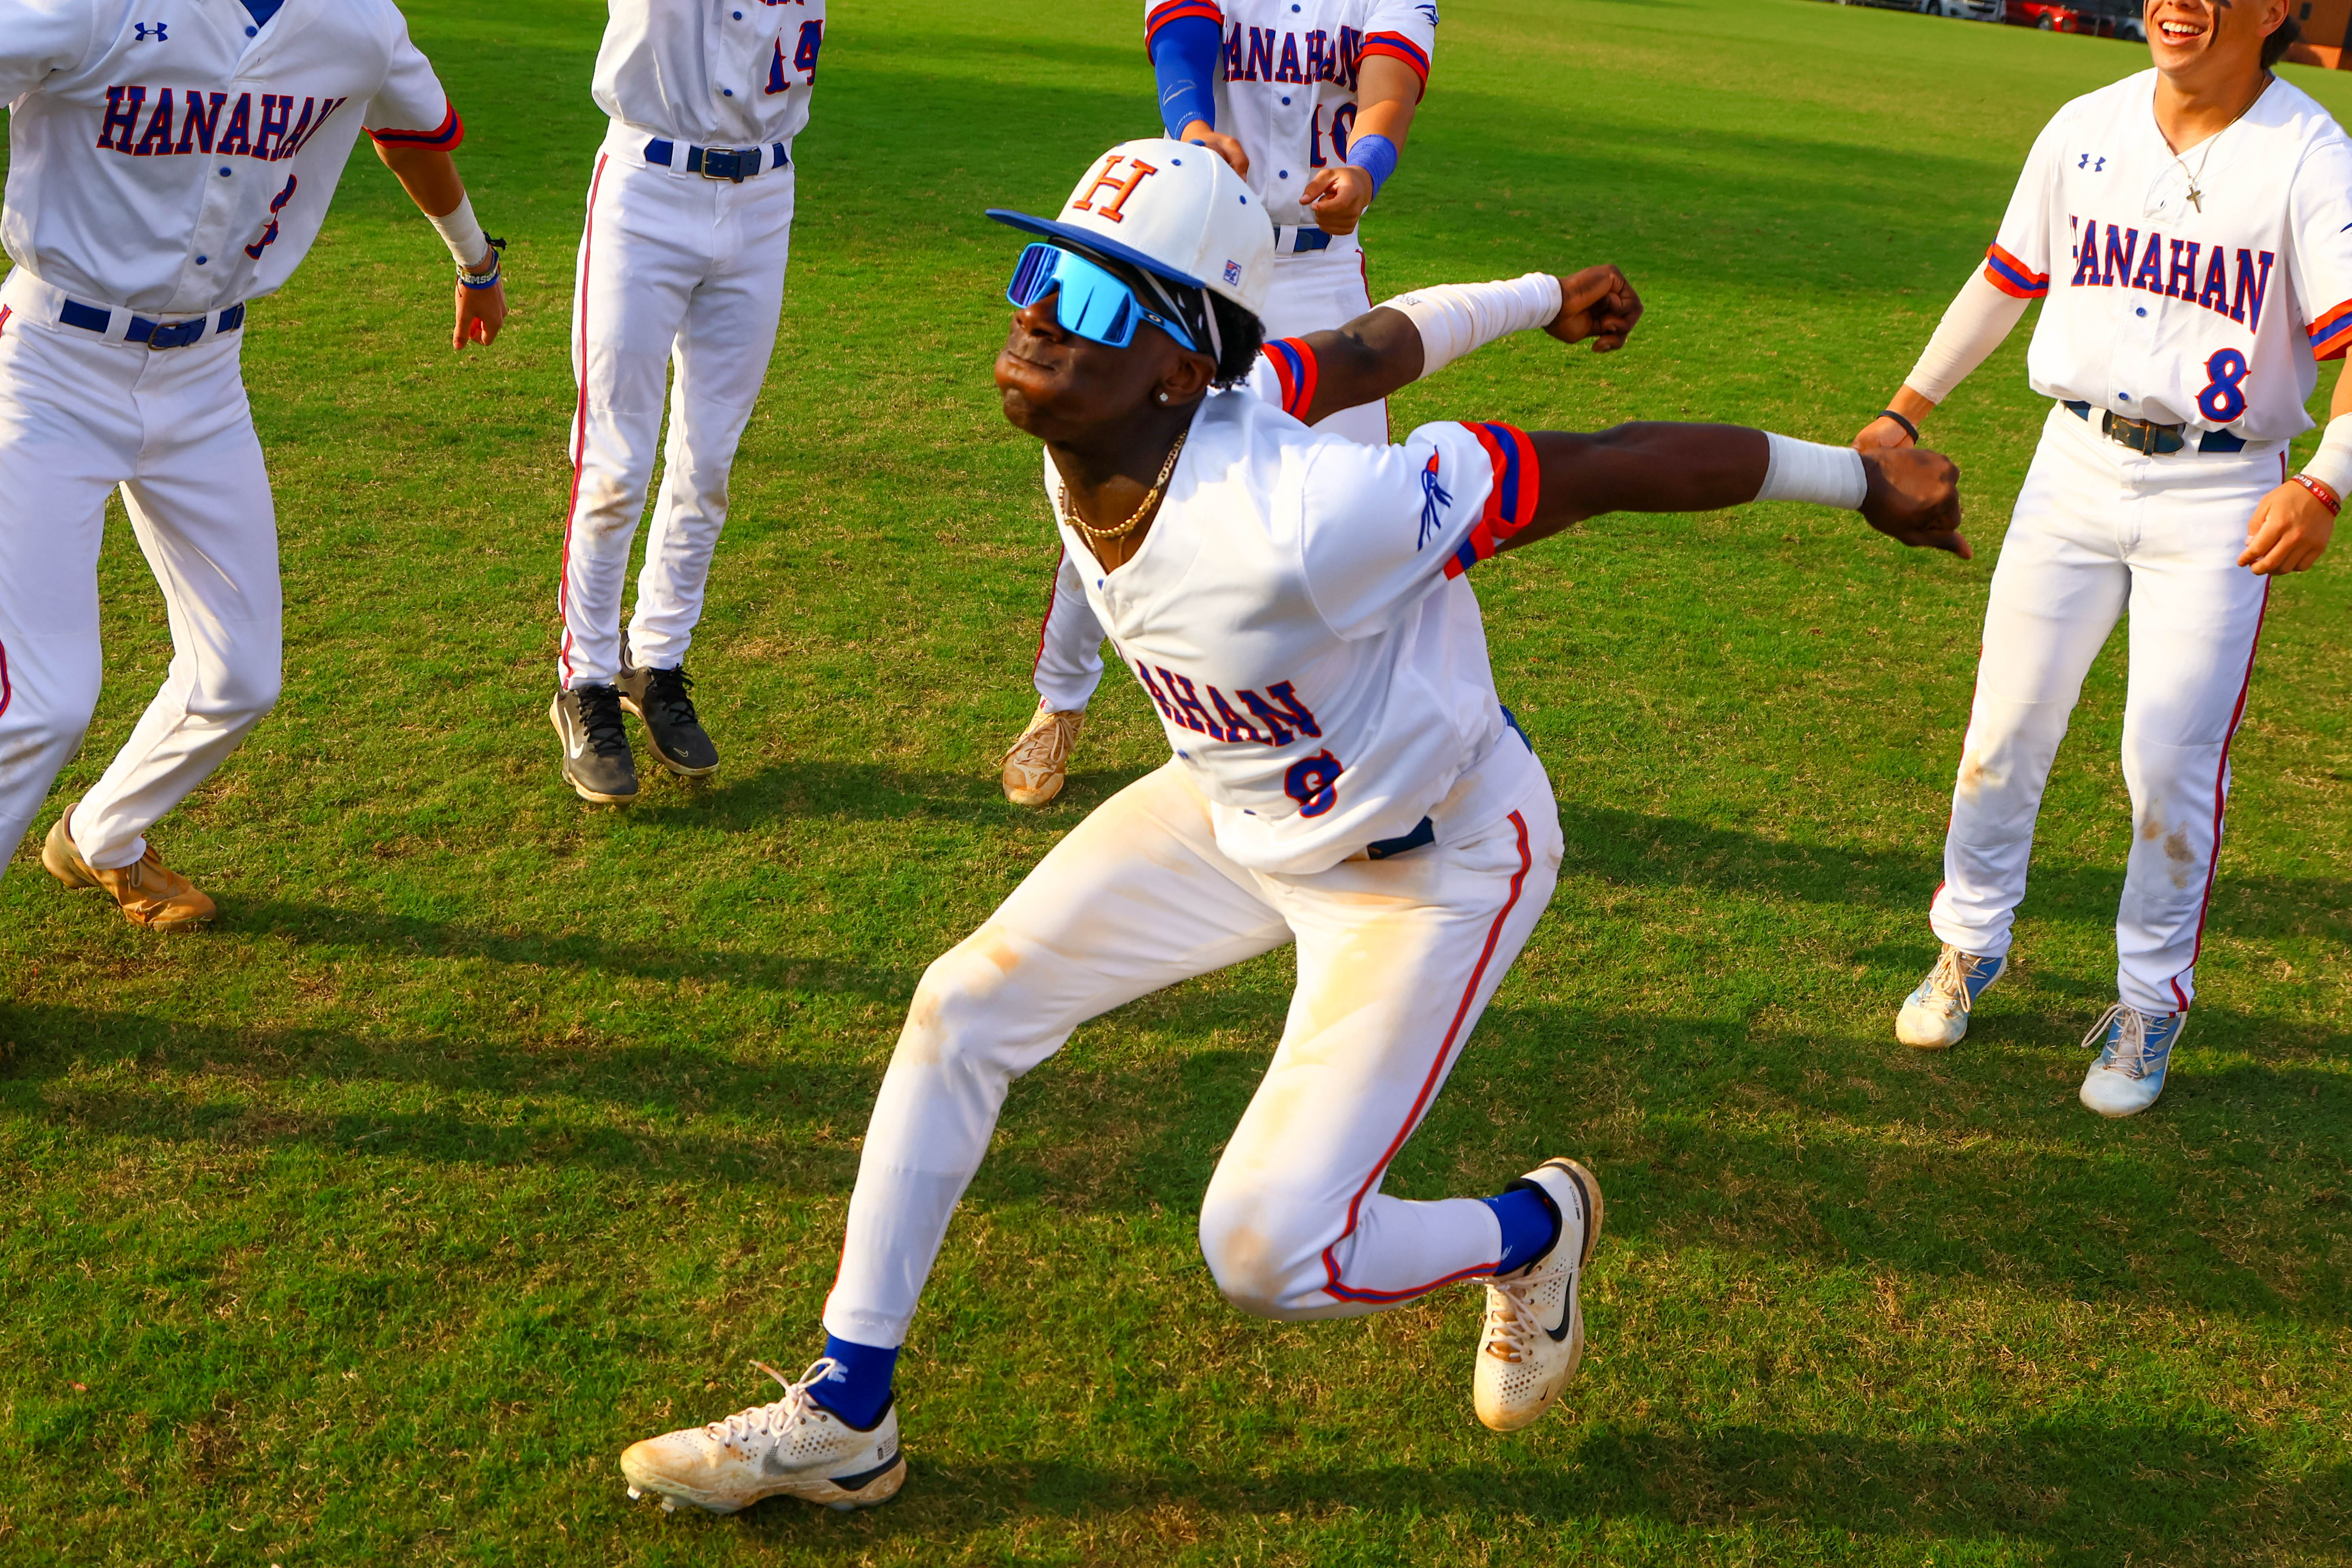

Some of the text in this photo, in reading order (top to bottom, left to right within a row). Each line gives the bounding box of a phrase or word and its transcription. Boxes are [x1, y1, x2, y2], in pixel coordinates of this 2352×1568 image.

[765, 19, 823, 95] 14
[1221, 15, 1362, 93] ANAHAN
[1073, 155, 1158, 223] H
[2194, 348, 2252, 423] 8
